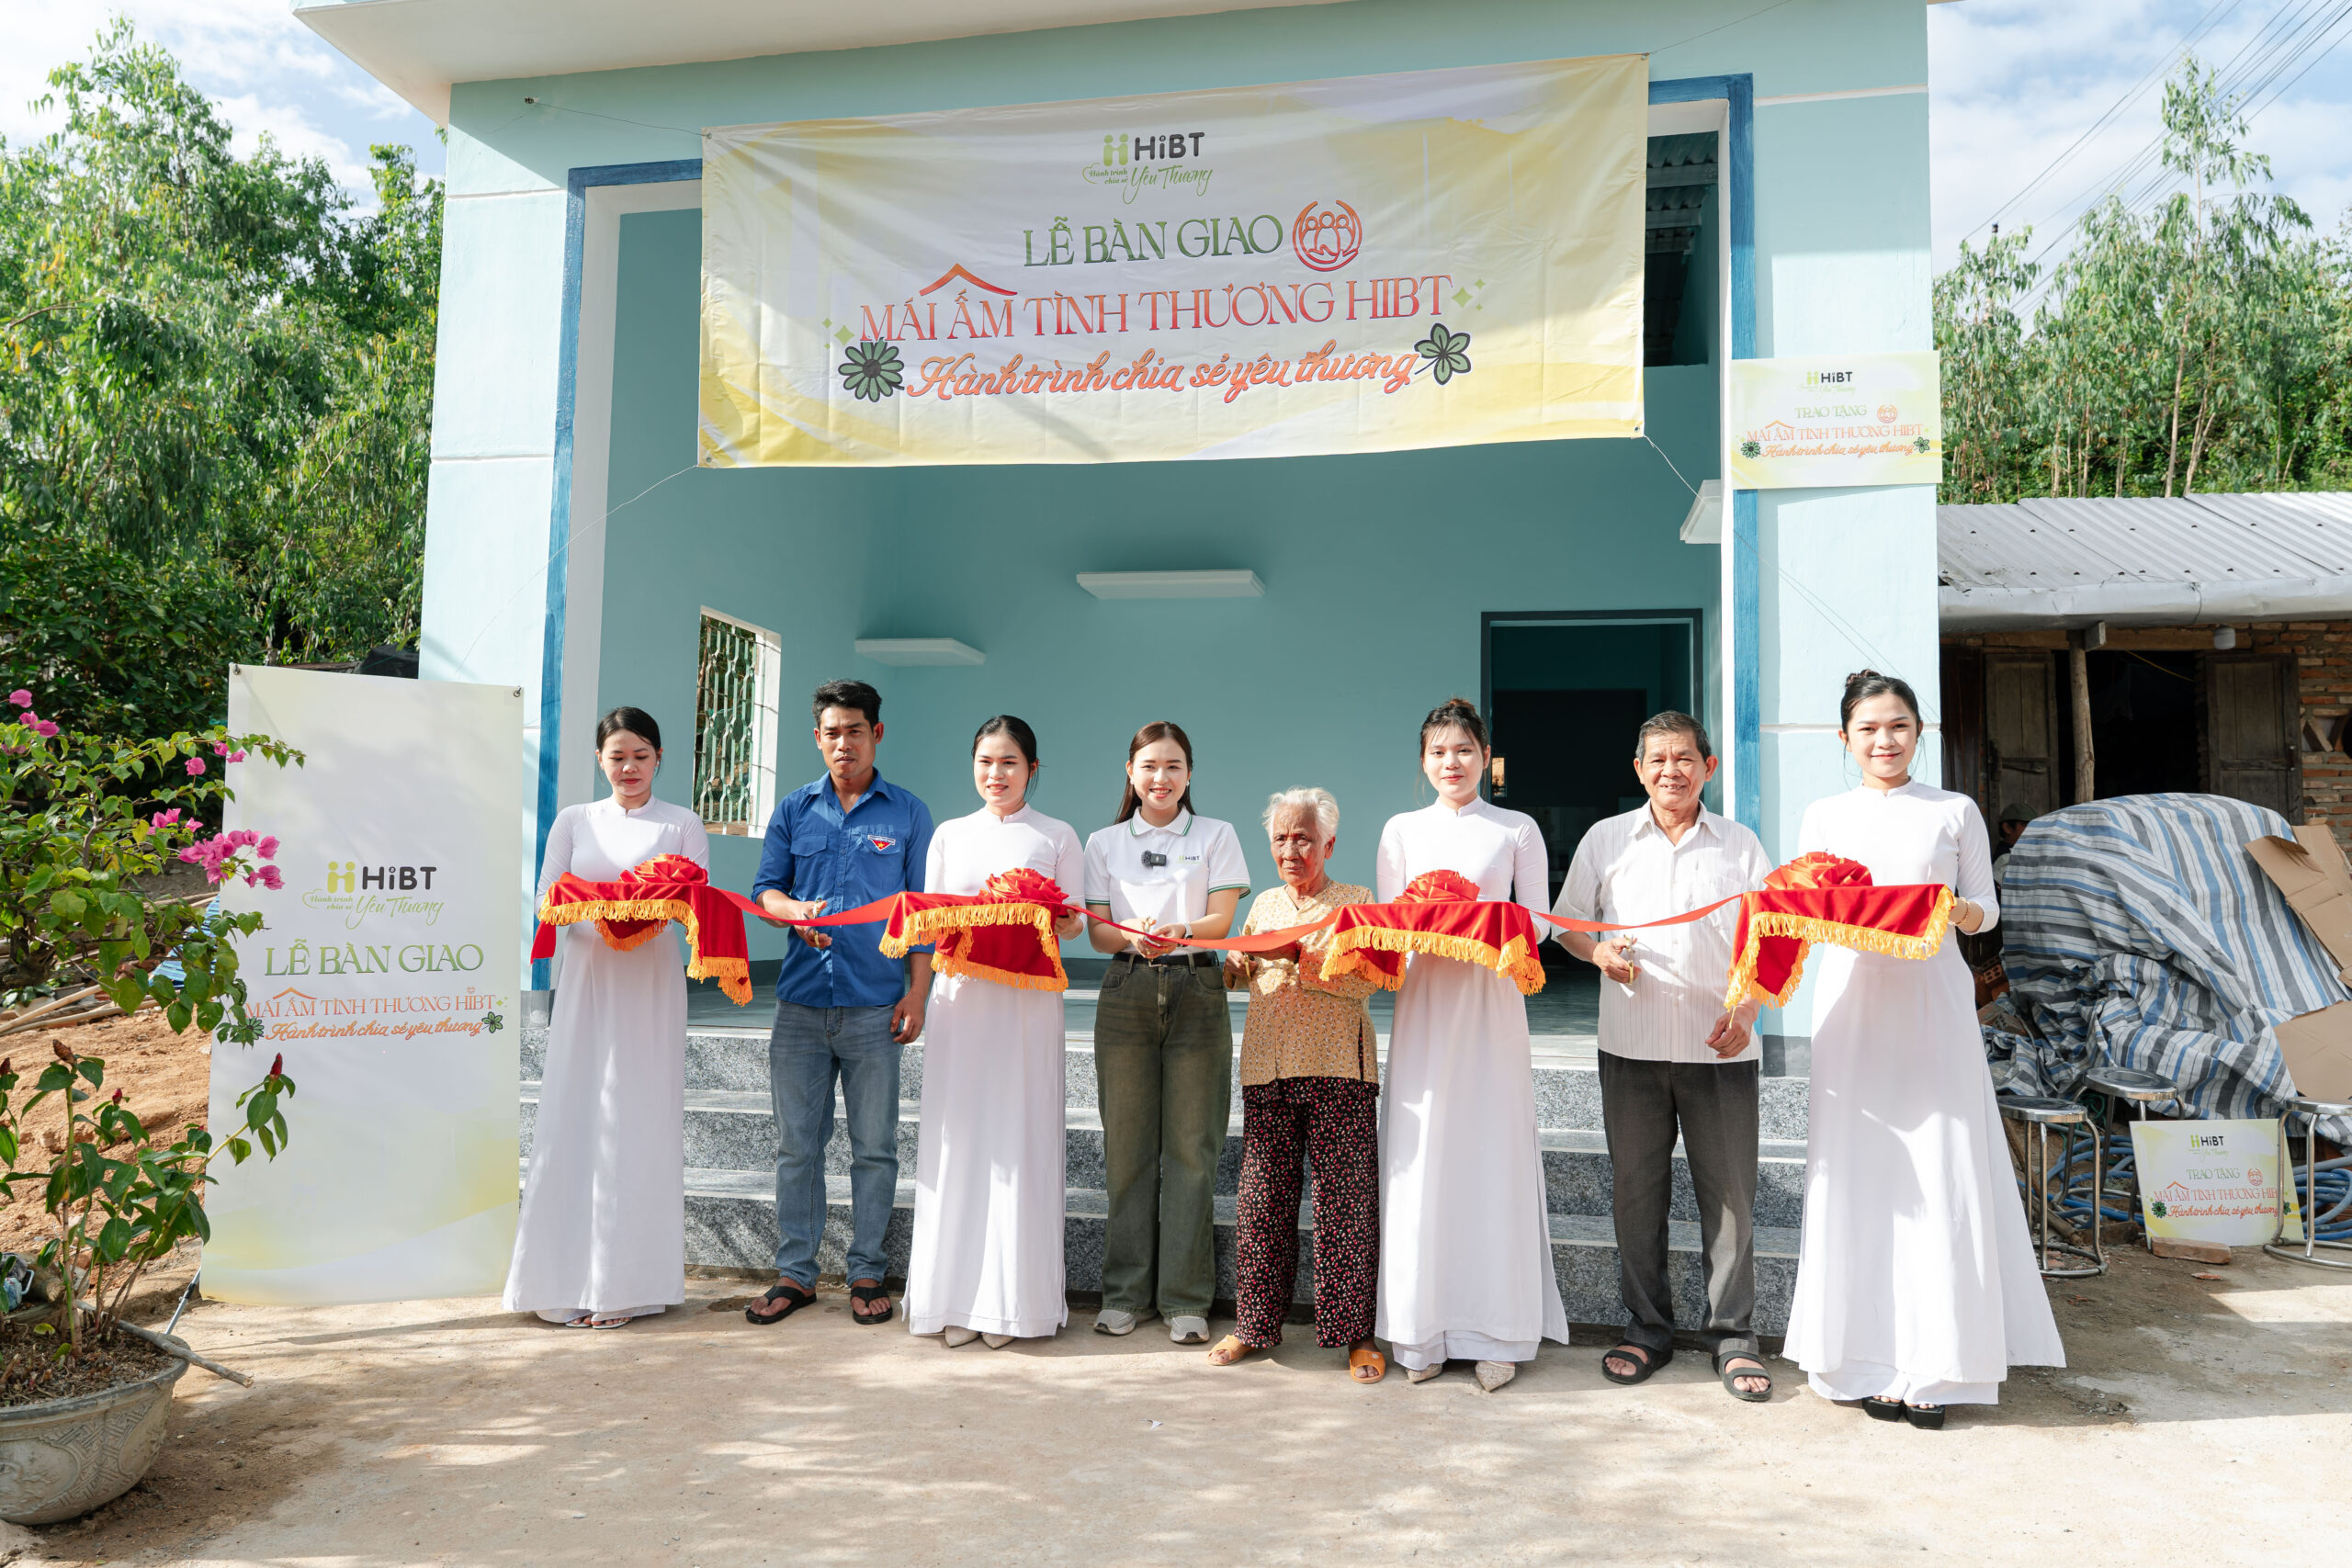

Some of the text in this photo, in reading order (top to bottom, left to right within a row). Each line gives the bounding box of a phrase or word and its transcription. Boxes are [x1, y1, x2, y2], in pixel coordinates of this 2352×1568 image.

[1123, 166, 1158, 205] Yêu
[1023, 214, 1283, 266] LỄ BÀN GIAO
[860, 275, 1453, 342] MÁI ẤM TÌNH THƯƠNG HIBT
[906, 339, 1419, 404] Hành trình chia sẻ yêu thương
[1794, 405, 1830, 419] TRAO
[1893, 423, 1923, 436] HIBT
[345, 895, 385, 930] Yêu
[265, 939, 484, 976] LỄ BÀN GIAO
[245, 995, 496, 1019] MÁI ẤM TÌNH THƯƠNG HIBT
[265, 1021, 322, 1042] Hành
[318, 1021, 358, 1038] trình
[356, 1020, 389, 1037] chia
[404, 1021, 434, 1041] yêu
[435, 1017, 483, 1037] thương
[2187, 1168, 2213, 1180] TRAO
